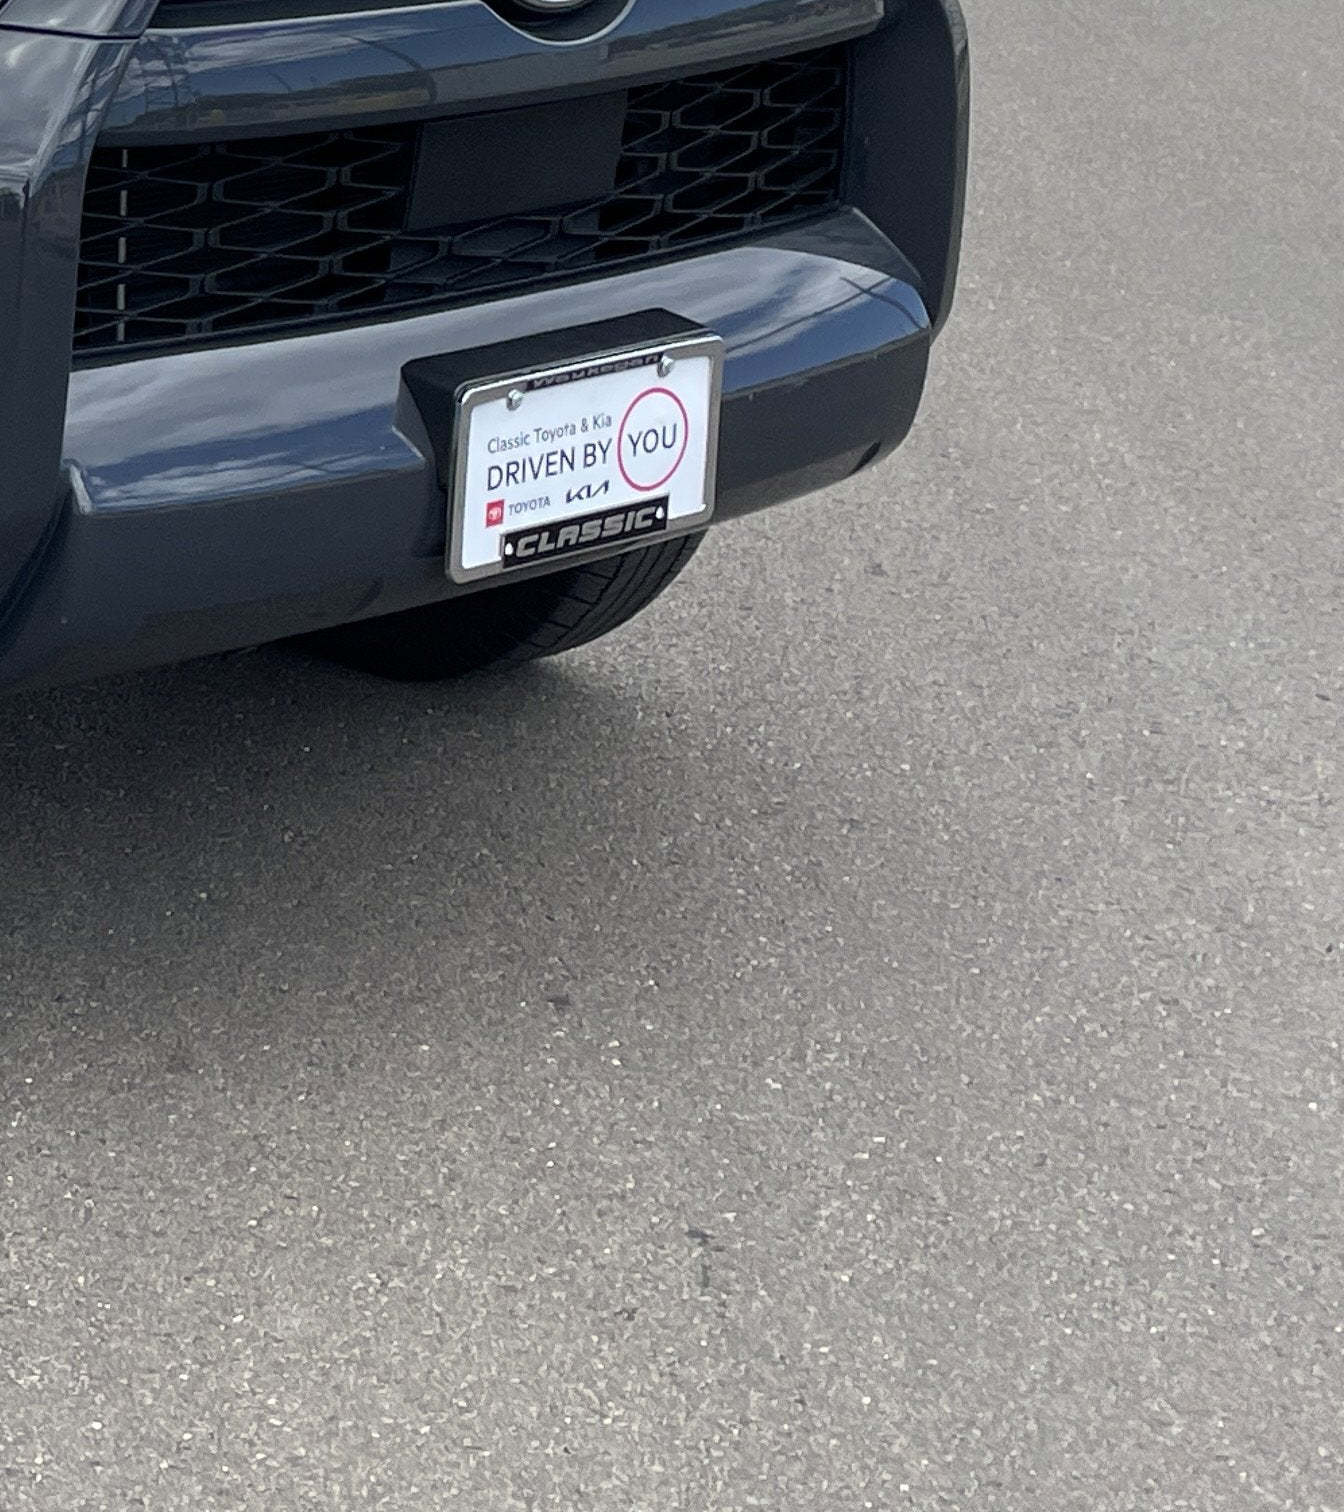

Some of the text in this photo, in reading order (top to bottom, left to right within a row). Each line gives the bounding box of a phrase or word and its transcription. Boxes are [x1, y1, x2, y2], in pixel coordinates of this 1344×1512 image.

[487, 412, 612, 454] Classic Toyota & Kia
[487, 423, 678, 491] DRIVEN BY YOU
[508, 480, 610, 516] TOYOTA KIA
[515, 506, 656, 558] CLASSIC
